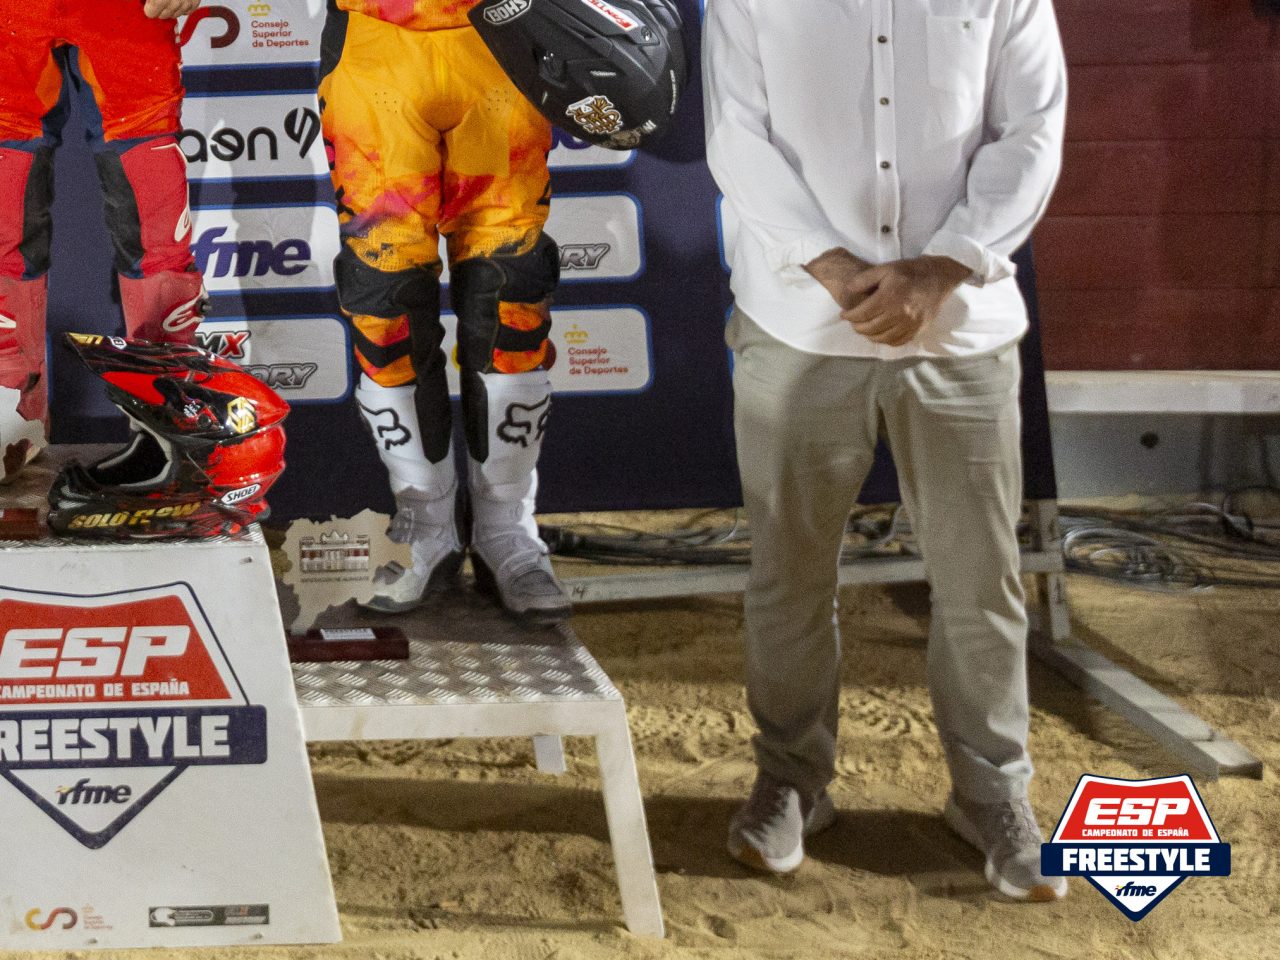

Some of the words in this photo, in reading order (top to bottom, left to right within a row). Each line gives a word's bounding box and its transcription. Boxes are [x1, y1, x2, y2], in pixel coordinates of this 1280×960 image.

[251, 18, 290, 31] Consejo
[252, 28, 292, 39] Superior
[252, 39, 265, 49] de
[266, 37, 310, 49] Deportes
[567, 346, 609, 358] Consejo
[568, 356, 611, 367] Superior
[569, 366, 582, 375] de
[583, 365, 630, 376] Deportes
[226, 485, 270, 503] SHOEI
[68, 509, 129, 529] SOLO
[103, 683, 125, 698] DE
[131, 677, 191, 697] ESPAÑA
[56, 777, 132, 806] rfme
